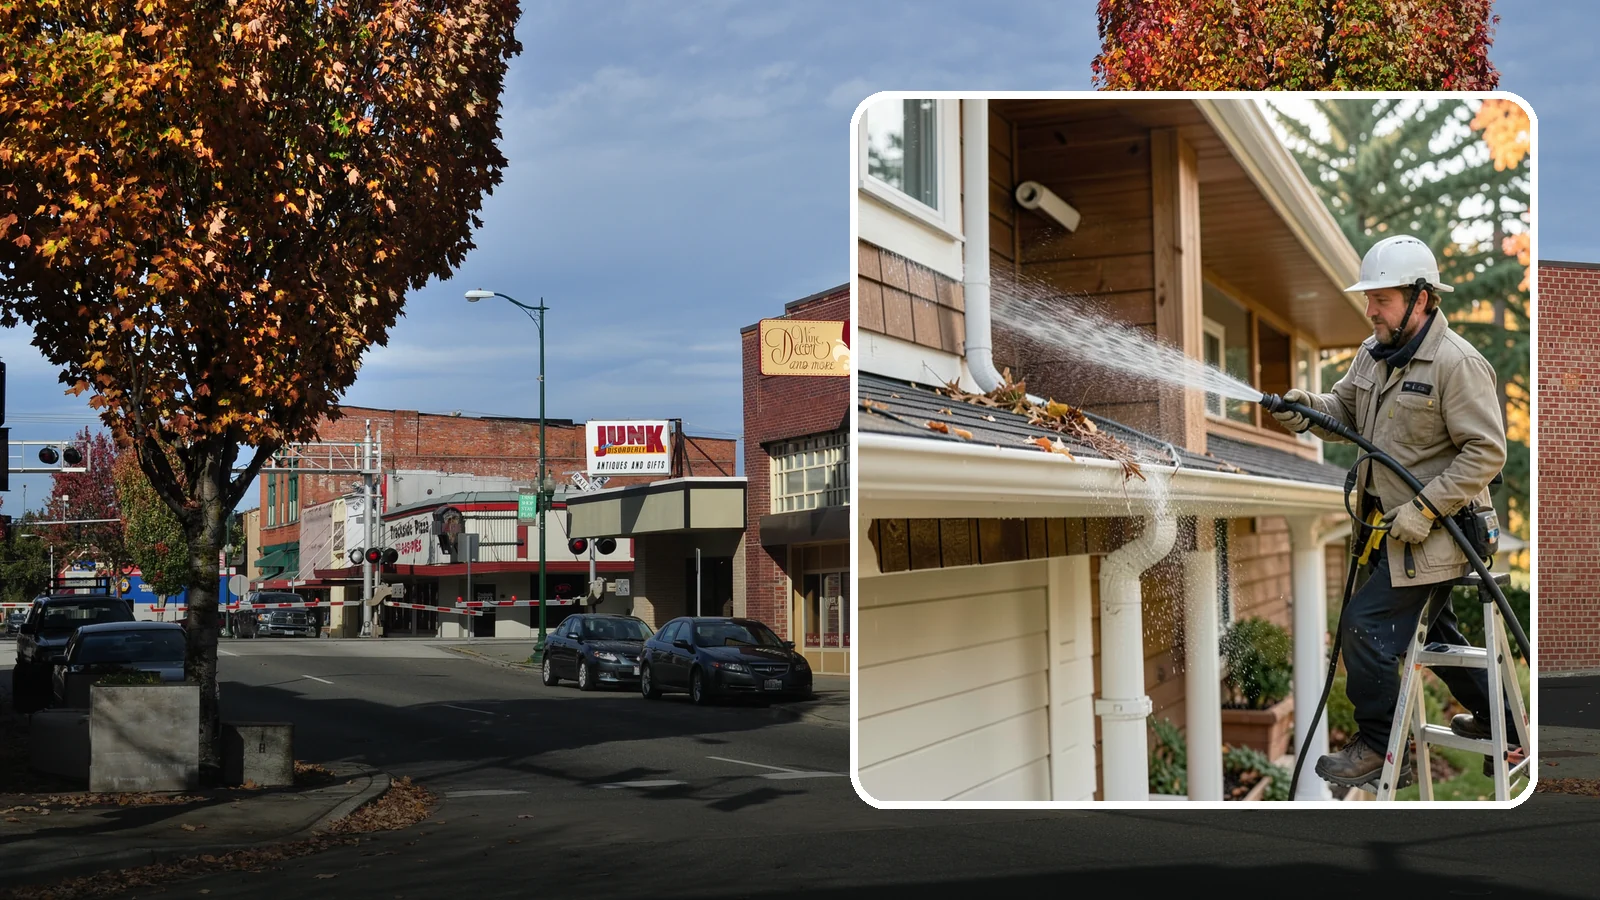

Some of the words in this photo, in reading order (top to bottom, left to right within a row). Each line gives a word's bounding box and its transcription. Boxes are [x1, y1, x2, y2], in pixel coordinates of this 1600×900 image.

[595, 424, 664, 457] JUNK
[607, 445, 646, 454] DISORDERLY
[597, 461, 628, 470] ANTIQUES
[631, 461, 643, 470] AND
[647, 460, 665, 470] GIFTS
[353, 498, 364, 510] CRO
